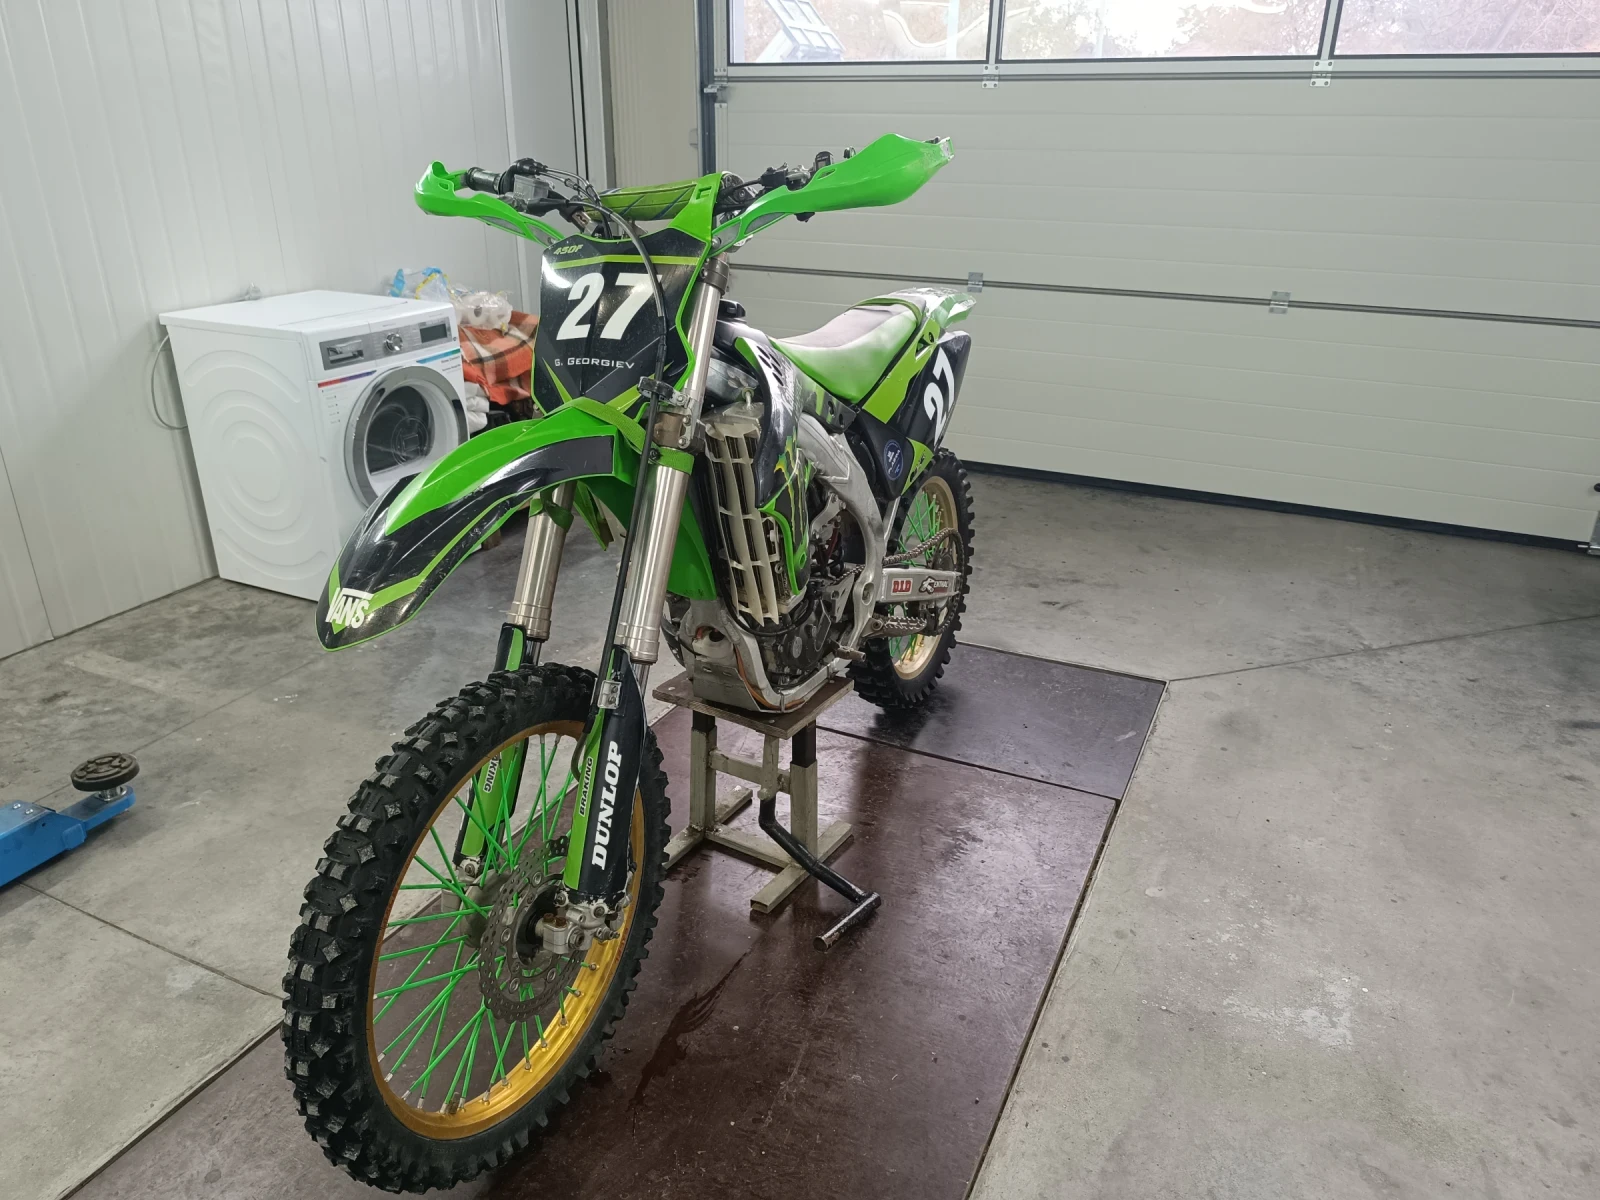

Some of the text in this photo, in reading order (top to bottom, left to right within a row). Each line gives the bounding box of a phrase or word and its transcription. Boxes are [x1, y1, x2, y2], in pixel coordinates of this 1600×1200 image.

[556, 272, 663, 340] 27
[555, 357, 635, 369] G. GEORGIEV
[325, 587, 374, 628] VANS
[484, 754, 500, 792] AKING
[579, 757, 593, 816] BRAKING
[592, 740, 622, 871] DUNLOP
